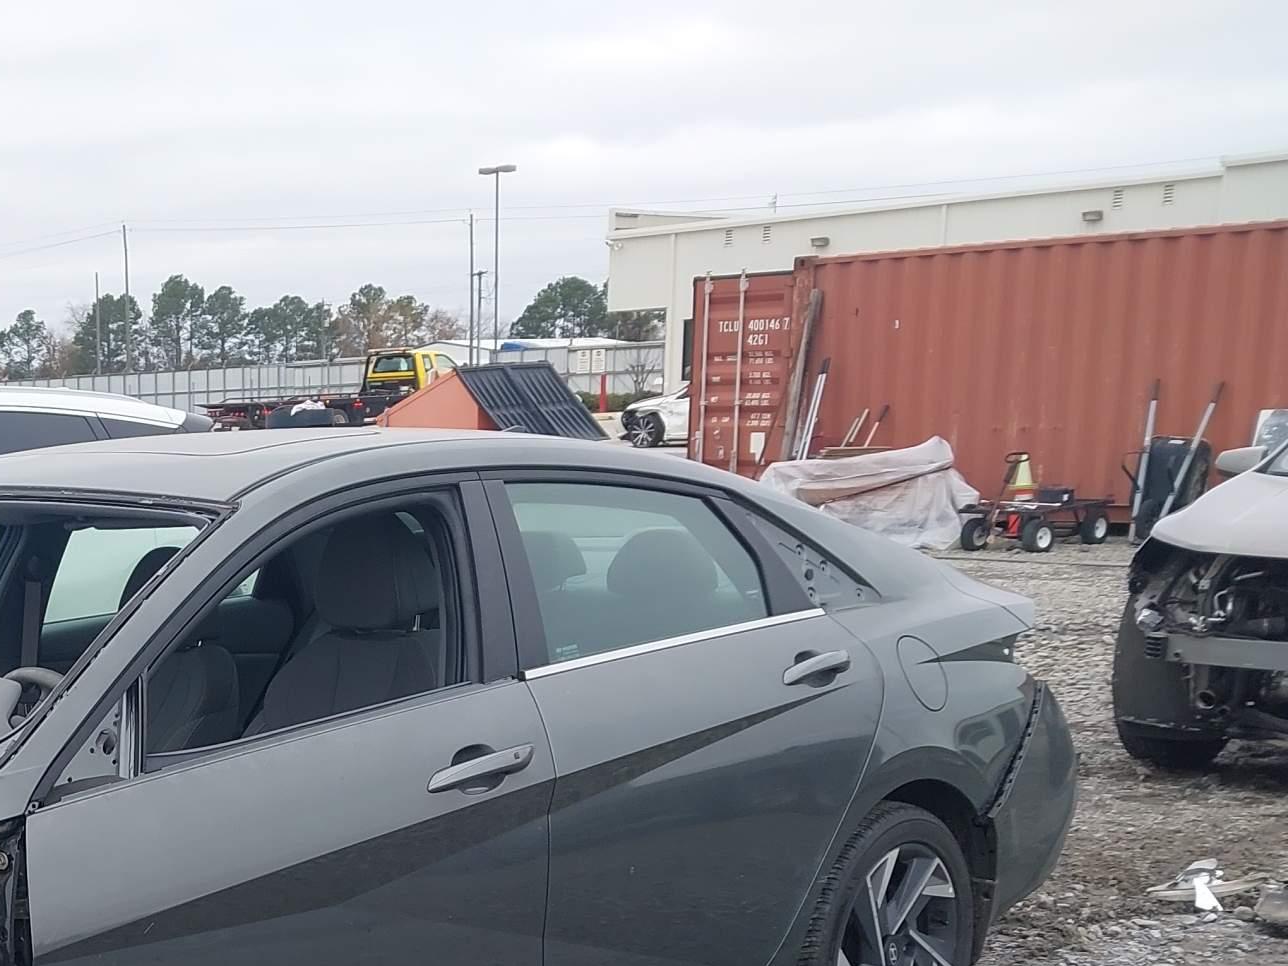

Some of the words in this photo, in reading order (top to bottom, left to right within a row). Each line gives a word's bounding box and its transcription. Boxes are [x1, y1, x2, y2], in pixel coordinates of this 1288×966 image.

[718, 320, 740, 332] TCLU
[748, 318, 780, 331] 400146
[747, 333, 769, 346] 42G1
